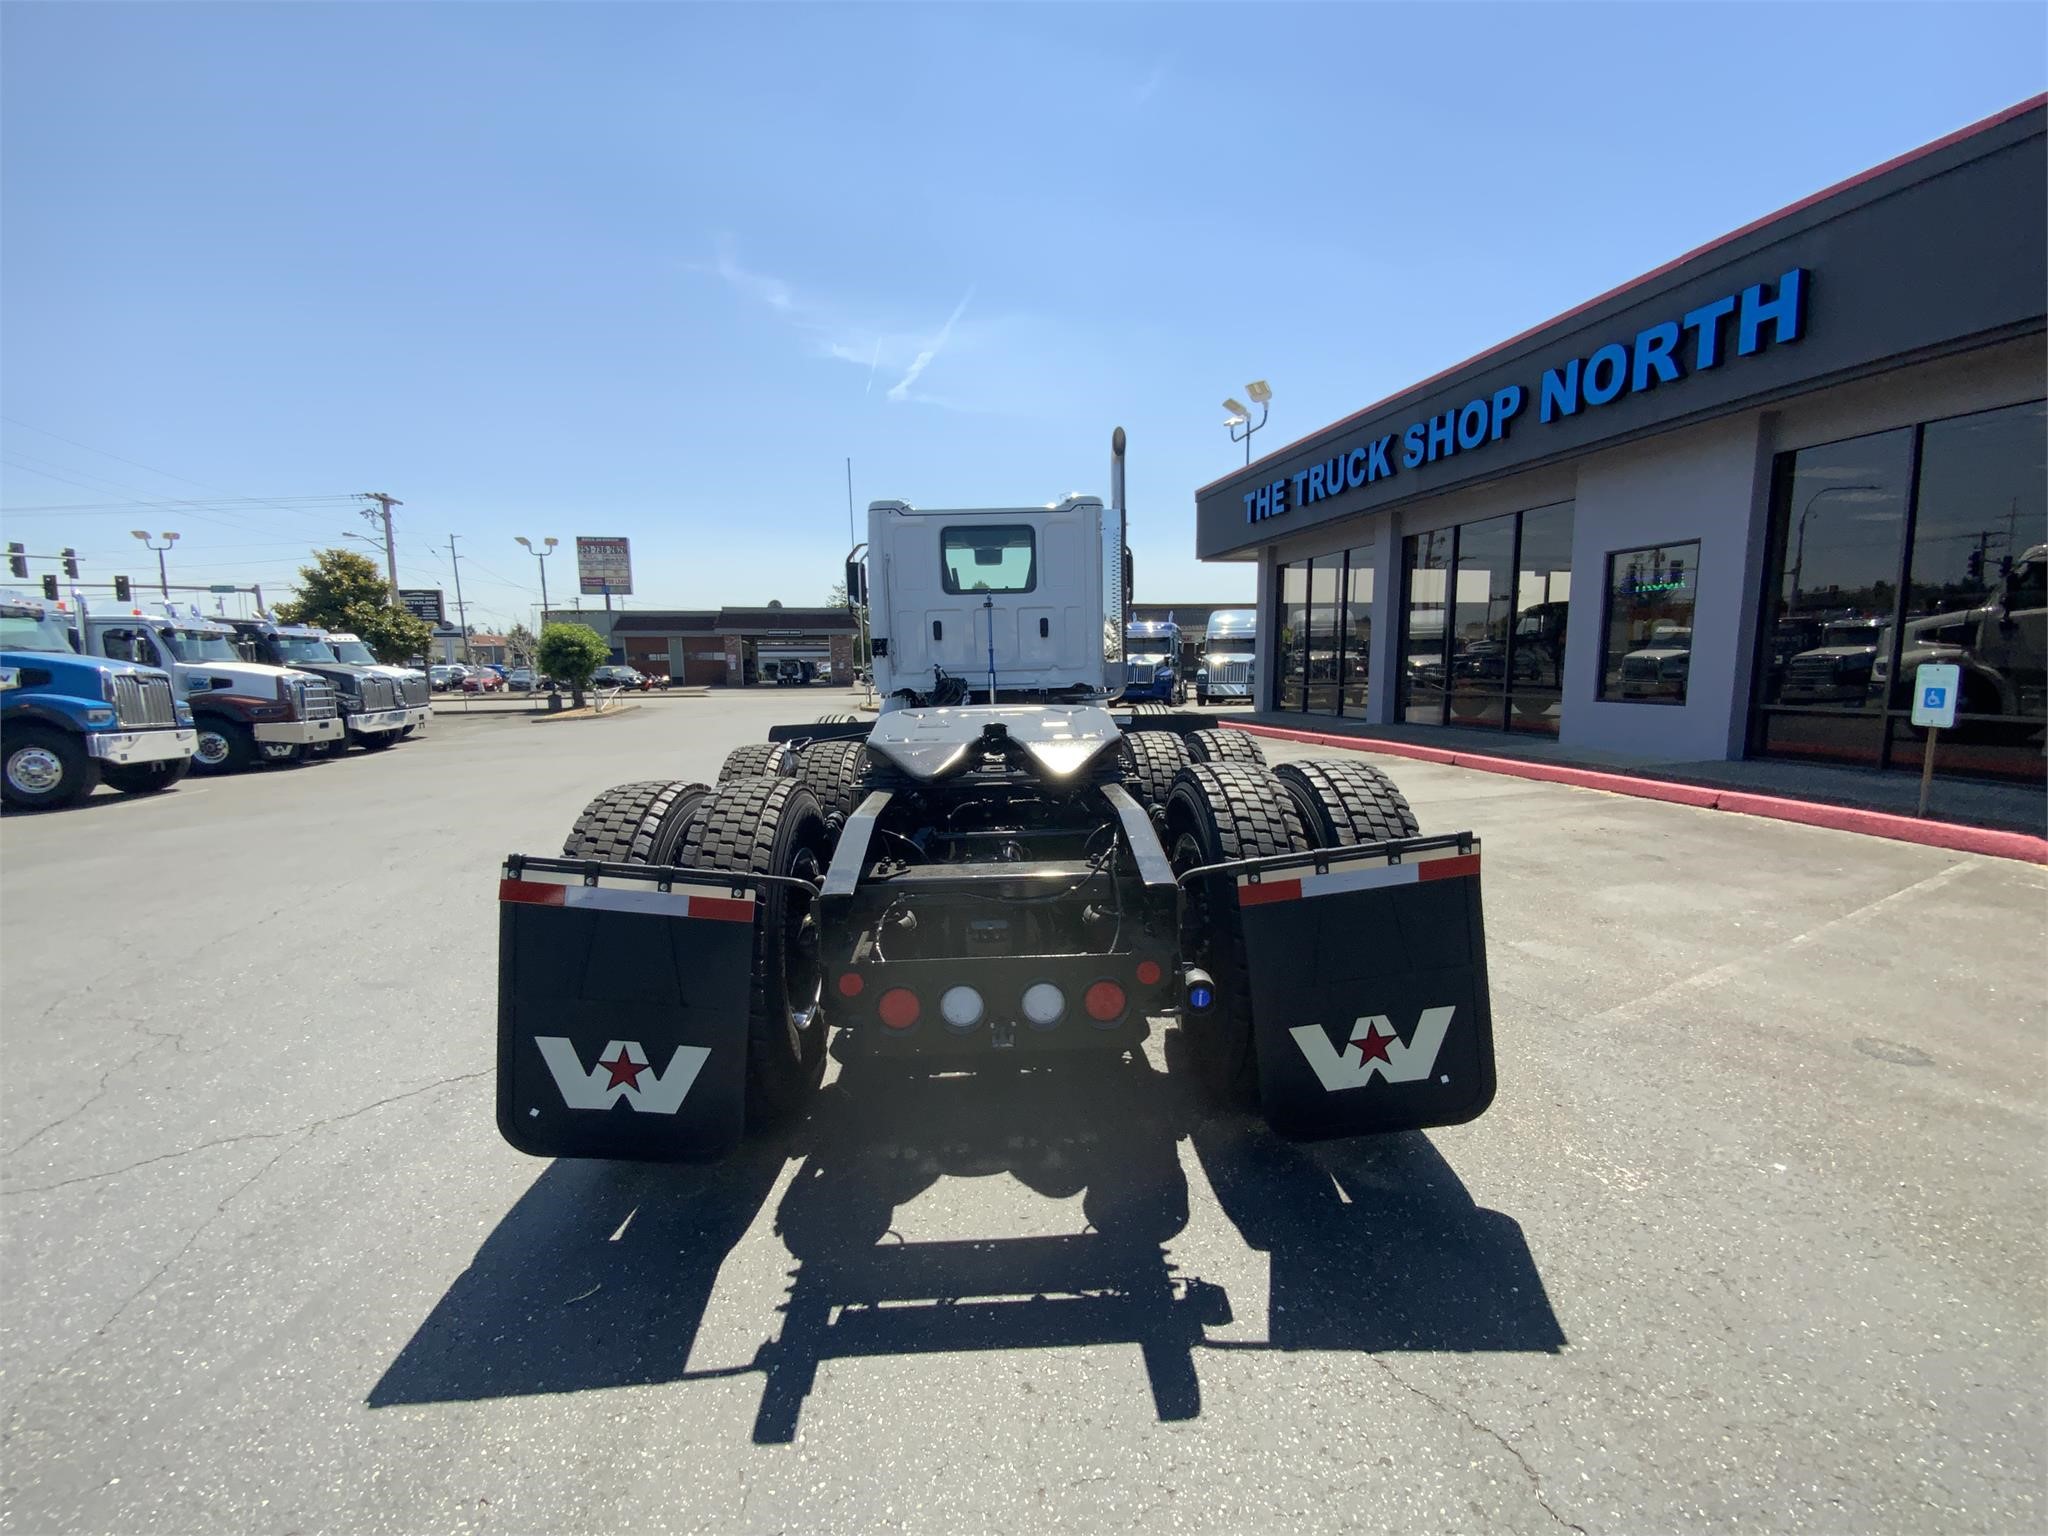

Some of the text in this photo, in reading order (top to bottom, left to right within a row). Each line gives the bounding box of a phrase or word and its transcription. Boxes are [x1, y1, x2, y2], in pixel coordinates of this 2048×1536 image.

[1243, 268, 1806, 524] THE TRUCK SHOP NORTH
